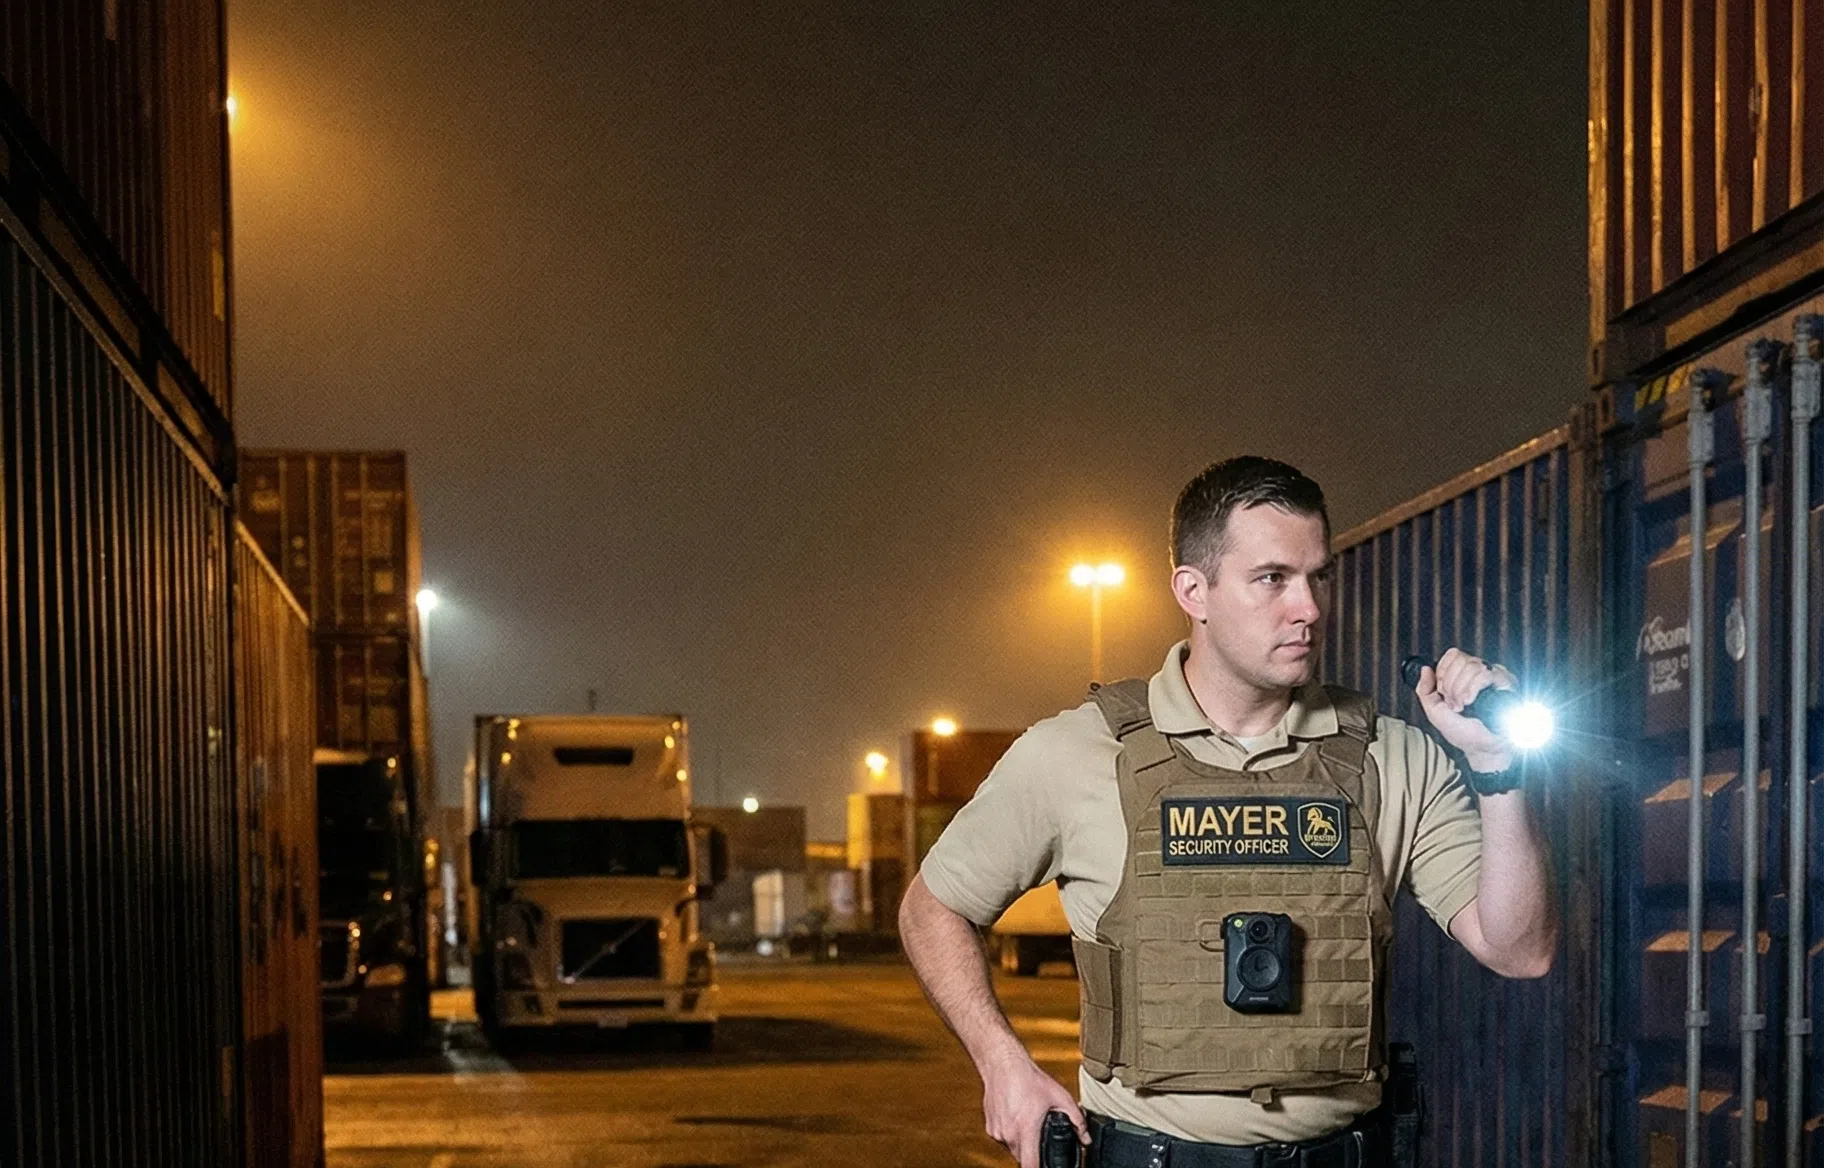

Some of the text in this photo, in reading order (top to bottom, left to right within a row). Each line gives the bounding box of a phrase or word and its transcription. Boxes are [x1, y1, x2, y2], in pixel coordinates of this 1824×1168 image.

[1169, 805, 1289, 836] MAYER
[1169, 839, 1289, 856] SECURITY OFFICER
